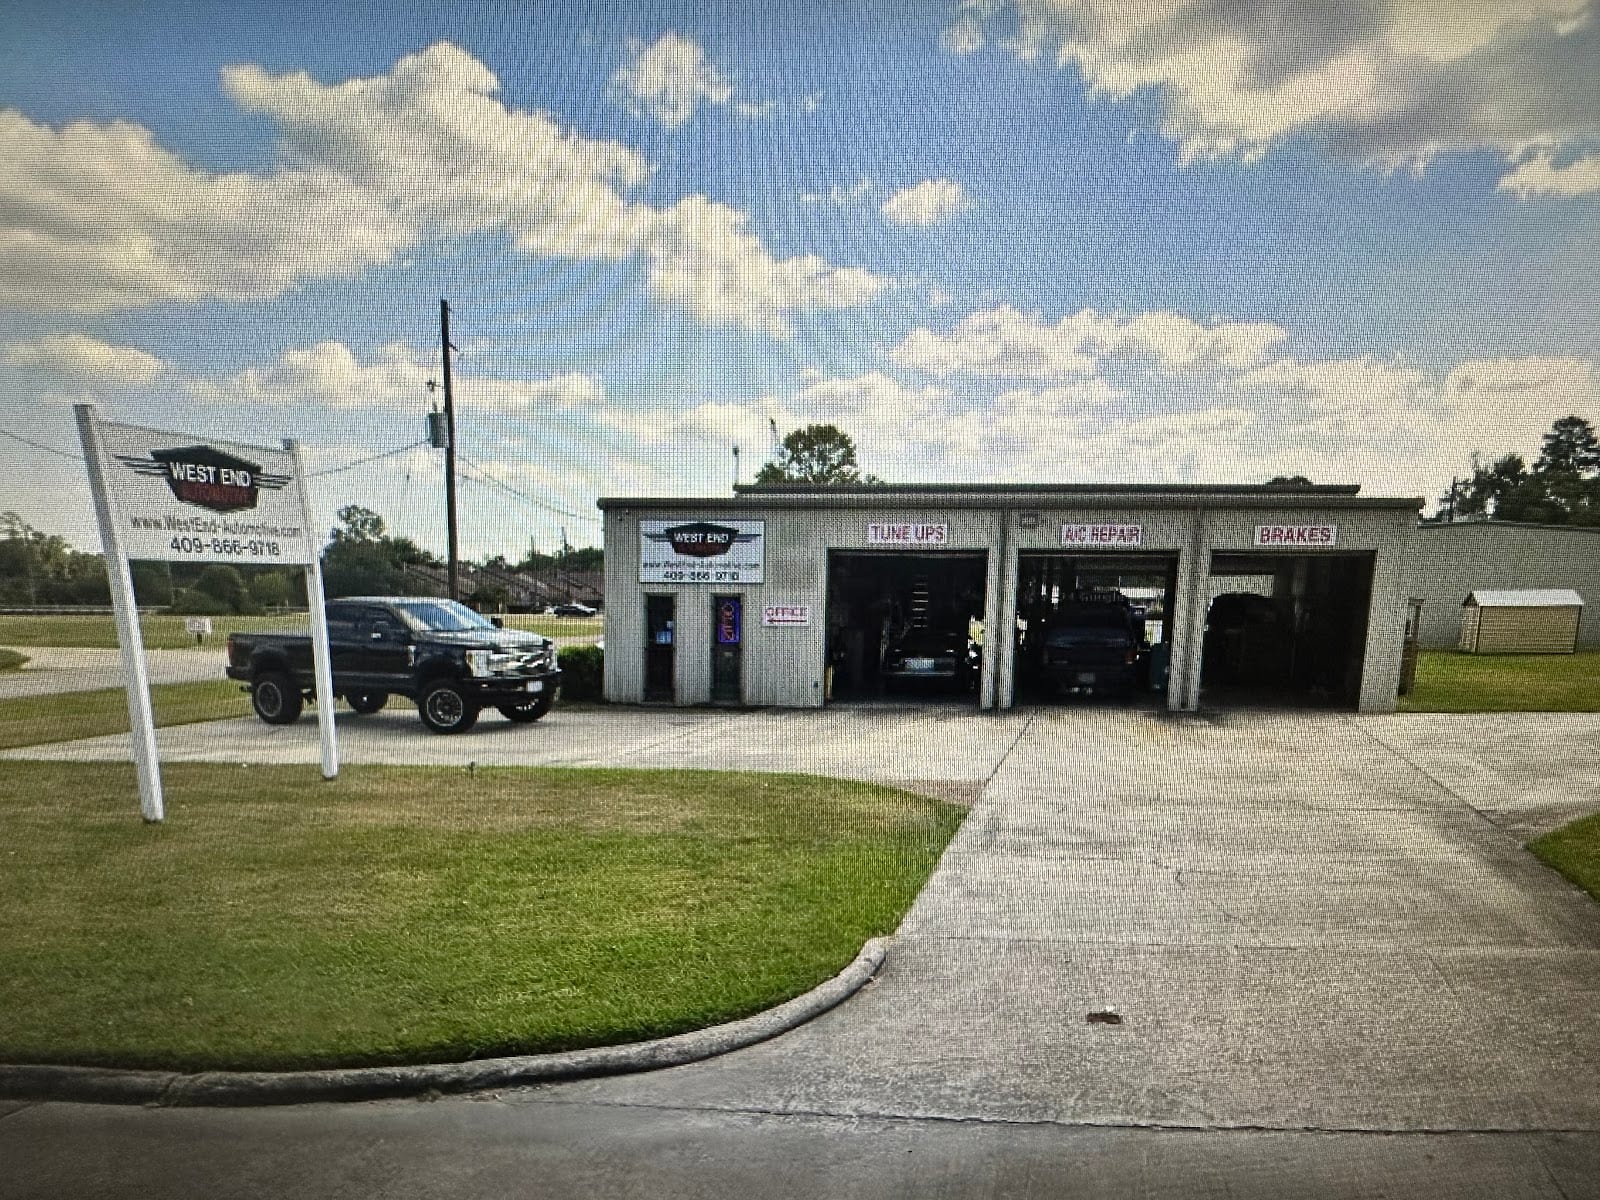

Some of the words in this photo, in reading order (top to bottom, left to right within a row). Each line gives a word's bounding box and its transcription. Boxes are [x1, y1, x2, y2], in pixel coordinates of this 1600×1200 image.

[169, 462, 216, 484] WEST
[220, 469, 251, 487] END
[674, 533, 703, 543] WEST
[706, 533, 729, 543] END
[870, 525, 910, 540] TUNE
[914, 525, 945, 540] UPS
[1091, 526, 1140, 542] REPAIR
[1260, 526, 1331, 544] BRAKES
[170, 537, 280, 555] 409-866-9718
[765, 606, 808, 618] OFFICE
